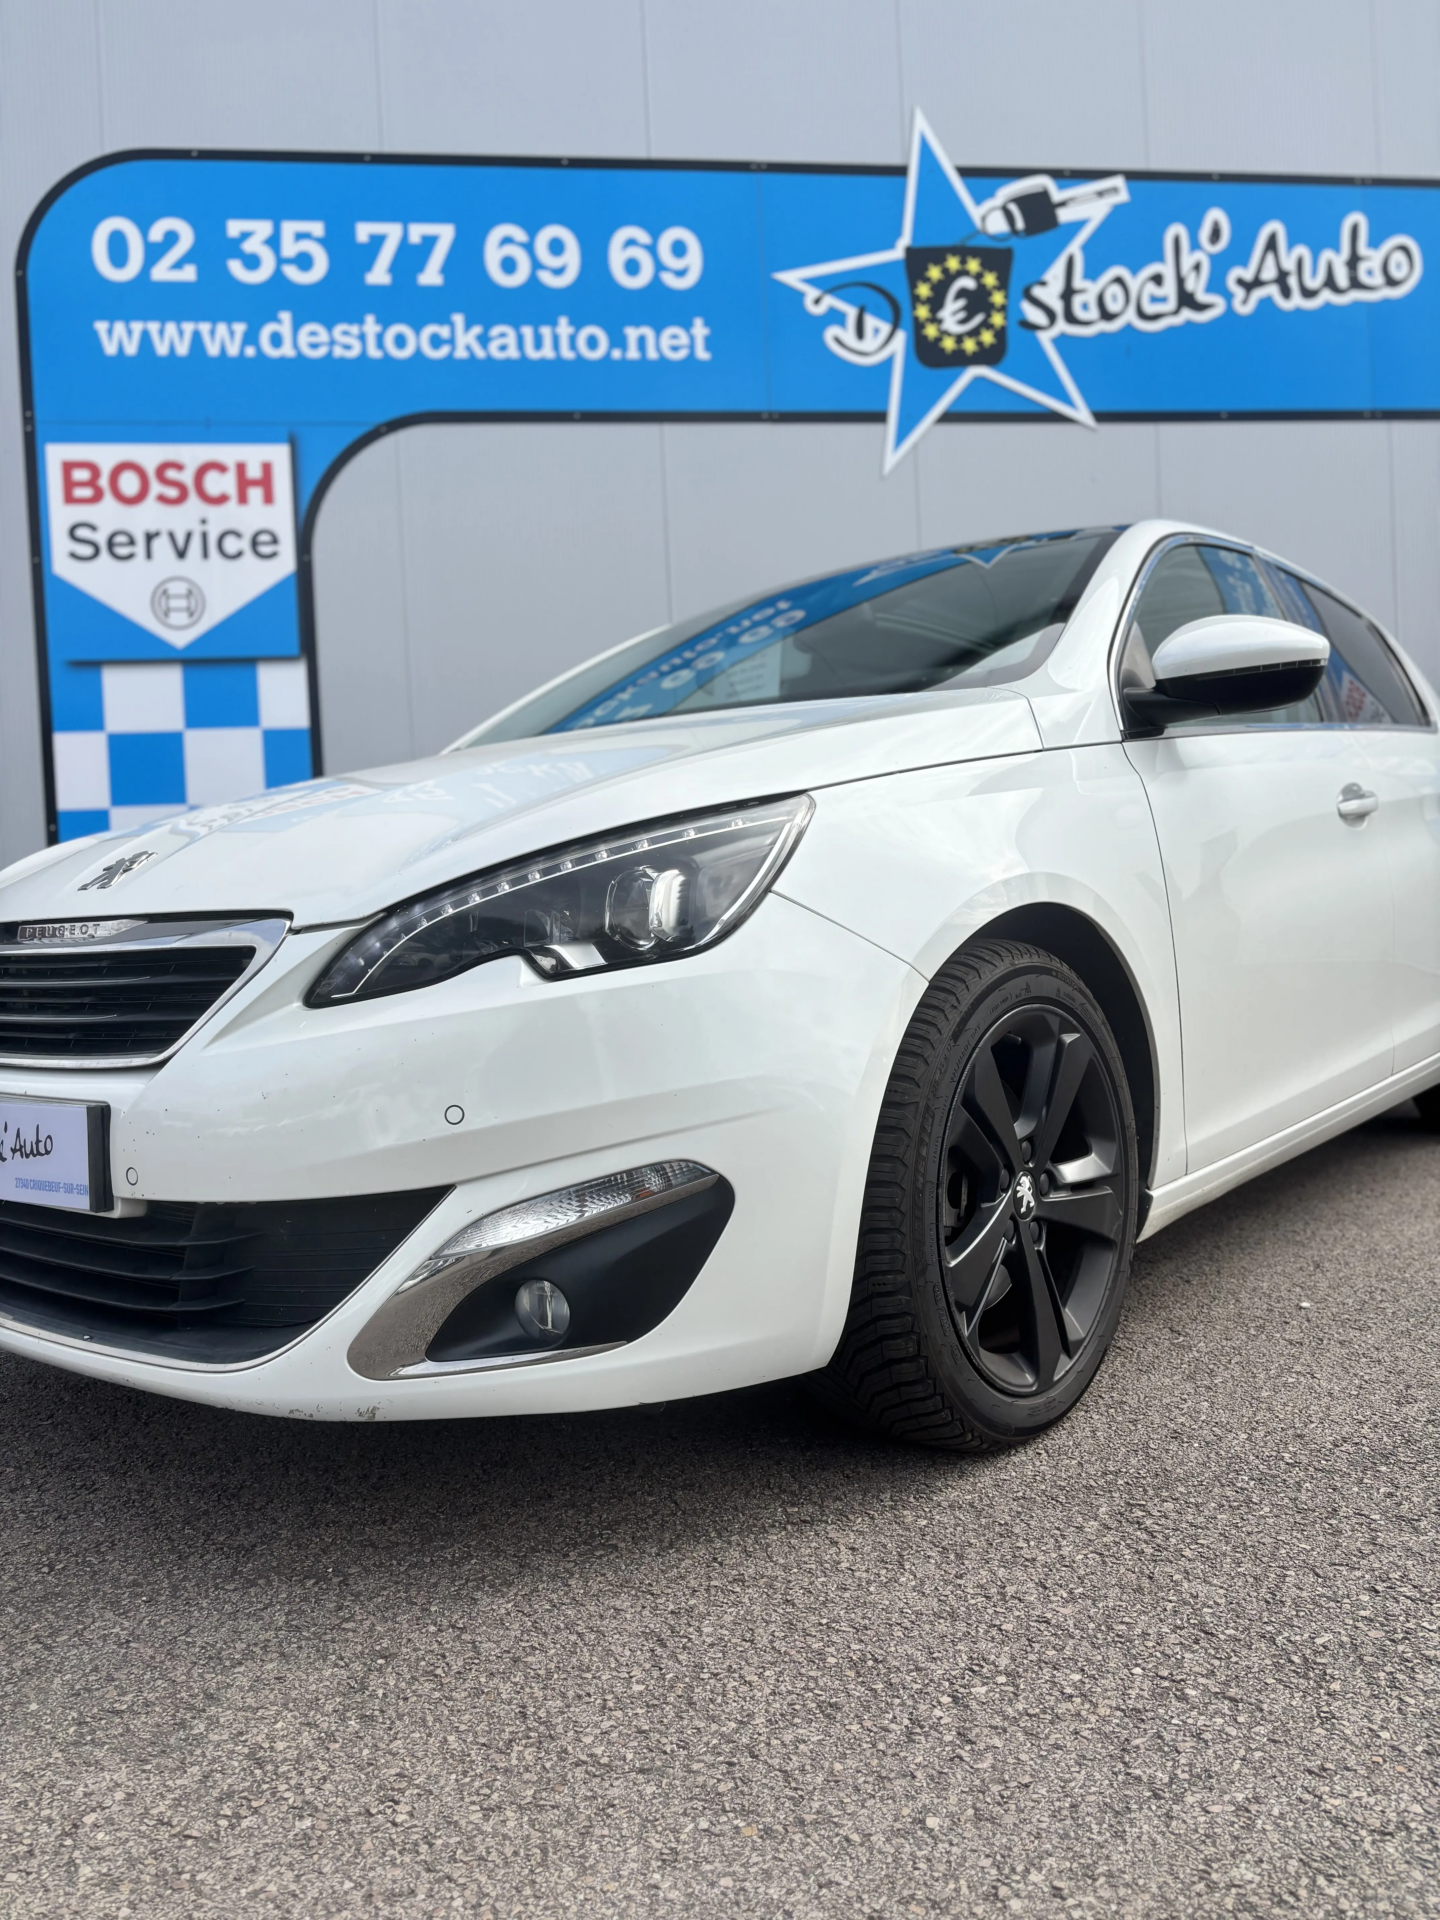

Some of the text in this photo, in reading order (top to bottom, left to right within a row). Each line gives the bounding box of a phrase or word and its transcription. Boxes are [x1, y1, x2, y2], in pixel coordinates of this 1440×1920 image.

[91, 216, 704, 290] 02 35 77 69 69
[93, 310, 712, 361] www.destockauto.net
[61, 460, 275, 506] BOSCH
[67, 519, 280, 562] Service
[25, 923, 101, 938] PEUGEOT
[29, 1178, 89, 1197] CRIQUEBEUF-SUR-SEIN
